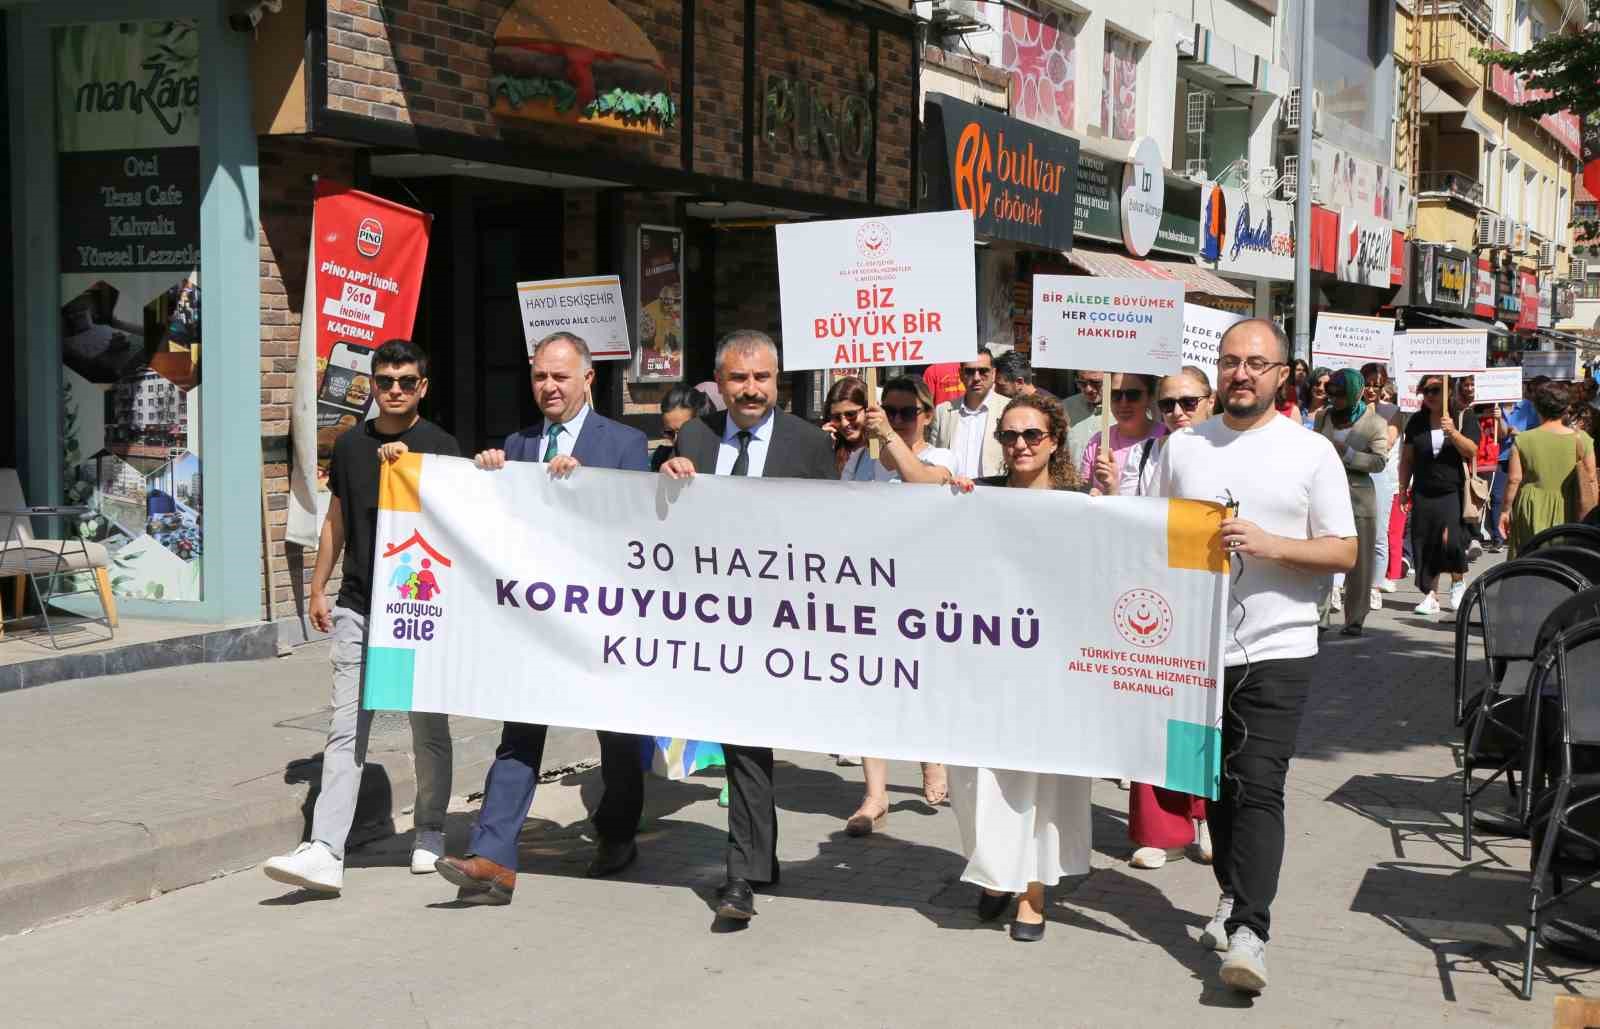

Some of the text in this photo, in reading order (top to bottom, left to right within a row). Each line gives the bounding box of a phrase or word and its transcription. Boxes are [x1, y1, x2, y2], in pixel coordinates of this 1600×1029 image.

[123, 156, 159, 177] Otel
[997, 129, 1065, 196] bulvar
[101, 185, 183, 207] Teras Cafe
[994, 189, 1043, 227] çibörek
[109, 215, 176, 236] Kahvaltı
[360, 227, 380, 243] PİNO
[77, 244, 200, 266] Yöresel Lezzetle
[321, 261, 346, 278] PİNO
[347, 286, 371, 305] %10
[526, 291, 614, 309] HAYDİ ESKİŞEHİR
[856, 284, 895, 310] BİZ
[1042, 290, 1174, 309] BİR AİLEDE BÜYÜMEK
[340, 304, 370, 322] İNDİRİM
[529, 317, 570, 328] KORUYUCU
[572, 315, 588, 325] AİLE
[814, 308, 941, 338] BÜYÜK BİR
[1062, 310, 1153, 324] HER ÇOCUĞUN
[327, 320, 374, 341] KAÇIRMA!
[1077, 327, 1137, 339] HAKKIDIR
[834, 338, 924, 364] AİLEYİZ
[627, 540, 896, 588] 30 HAZİRAN
[495, 578, 1039, 649] KORUYUCU AİLE GÜNÜ
[393, 617, 434, 641] aile
[603, 635, 919, 690] KUTLU OLSUN
[1080, 647, 1206, 672] TÜRKİYE CUMHURİYETİ
[1068, 661, 1216, 689] AİLE VE SOSYAL HİZMETLER
[1113, 680, 1174, 697] BAKANLIĞI
